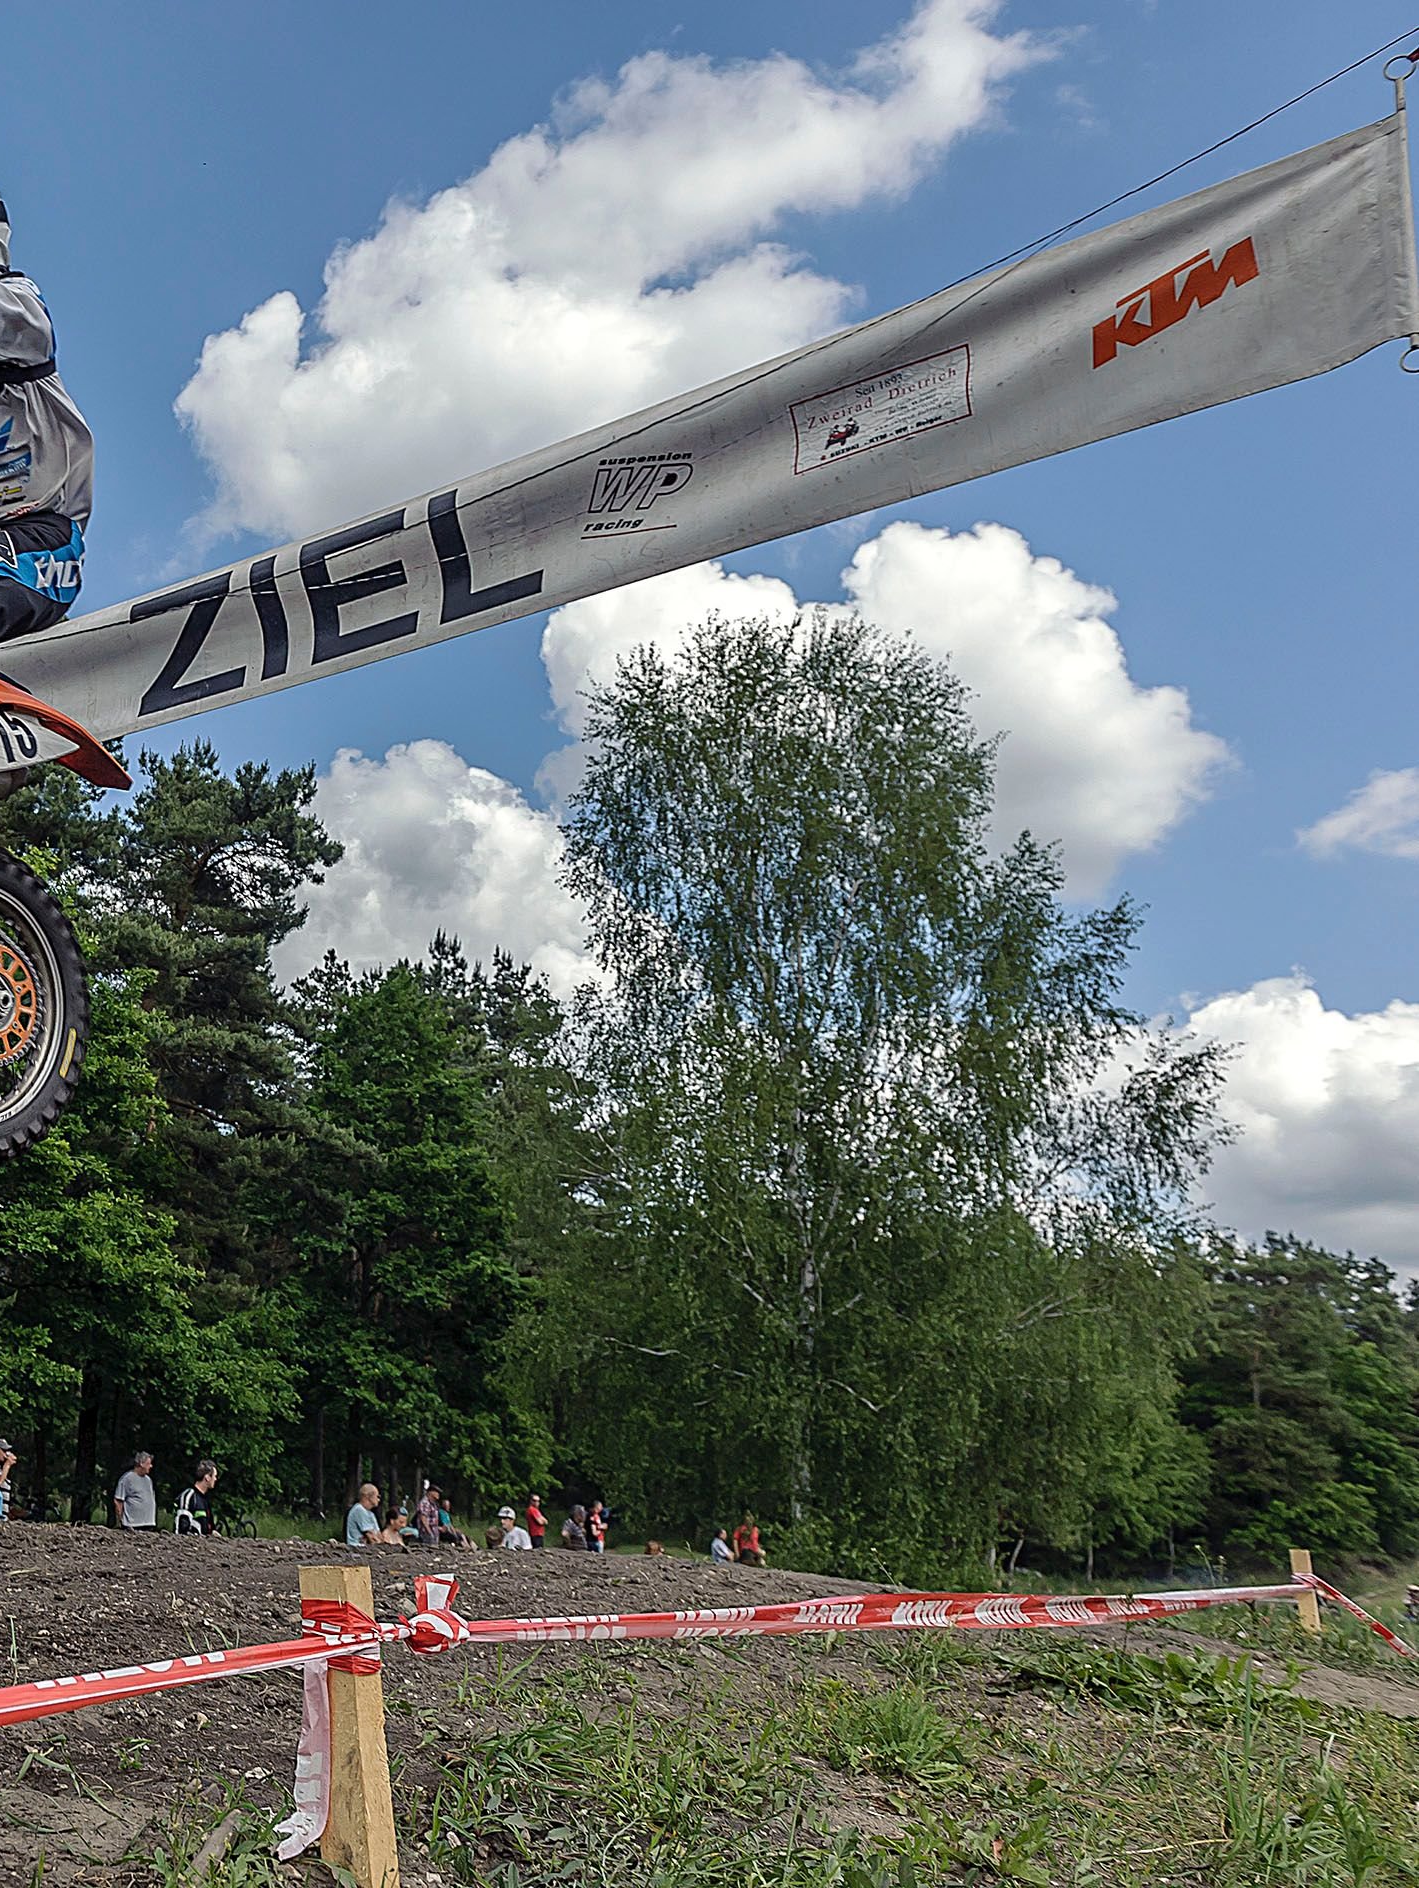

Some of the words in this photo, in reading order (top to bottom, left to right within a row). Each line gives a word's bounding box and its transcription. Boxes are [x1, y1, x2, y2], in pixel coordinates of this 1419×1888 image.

[1093, 236, 1259, 369] KTM
[807, 397, 873, 429] Zweirad
[888, 368, 956, 400] Dietrich
[878, 373, 904, 390] 1893
[598, 452, 693, 466] suspension
[587, 463, 693, 513] WP
[583, 519, 644, 532] racing
[130, 489, 544, 717] ZIEL
